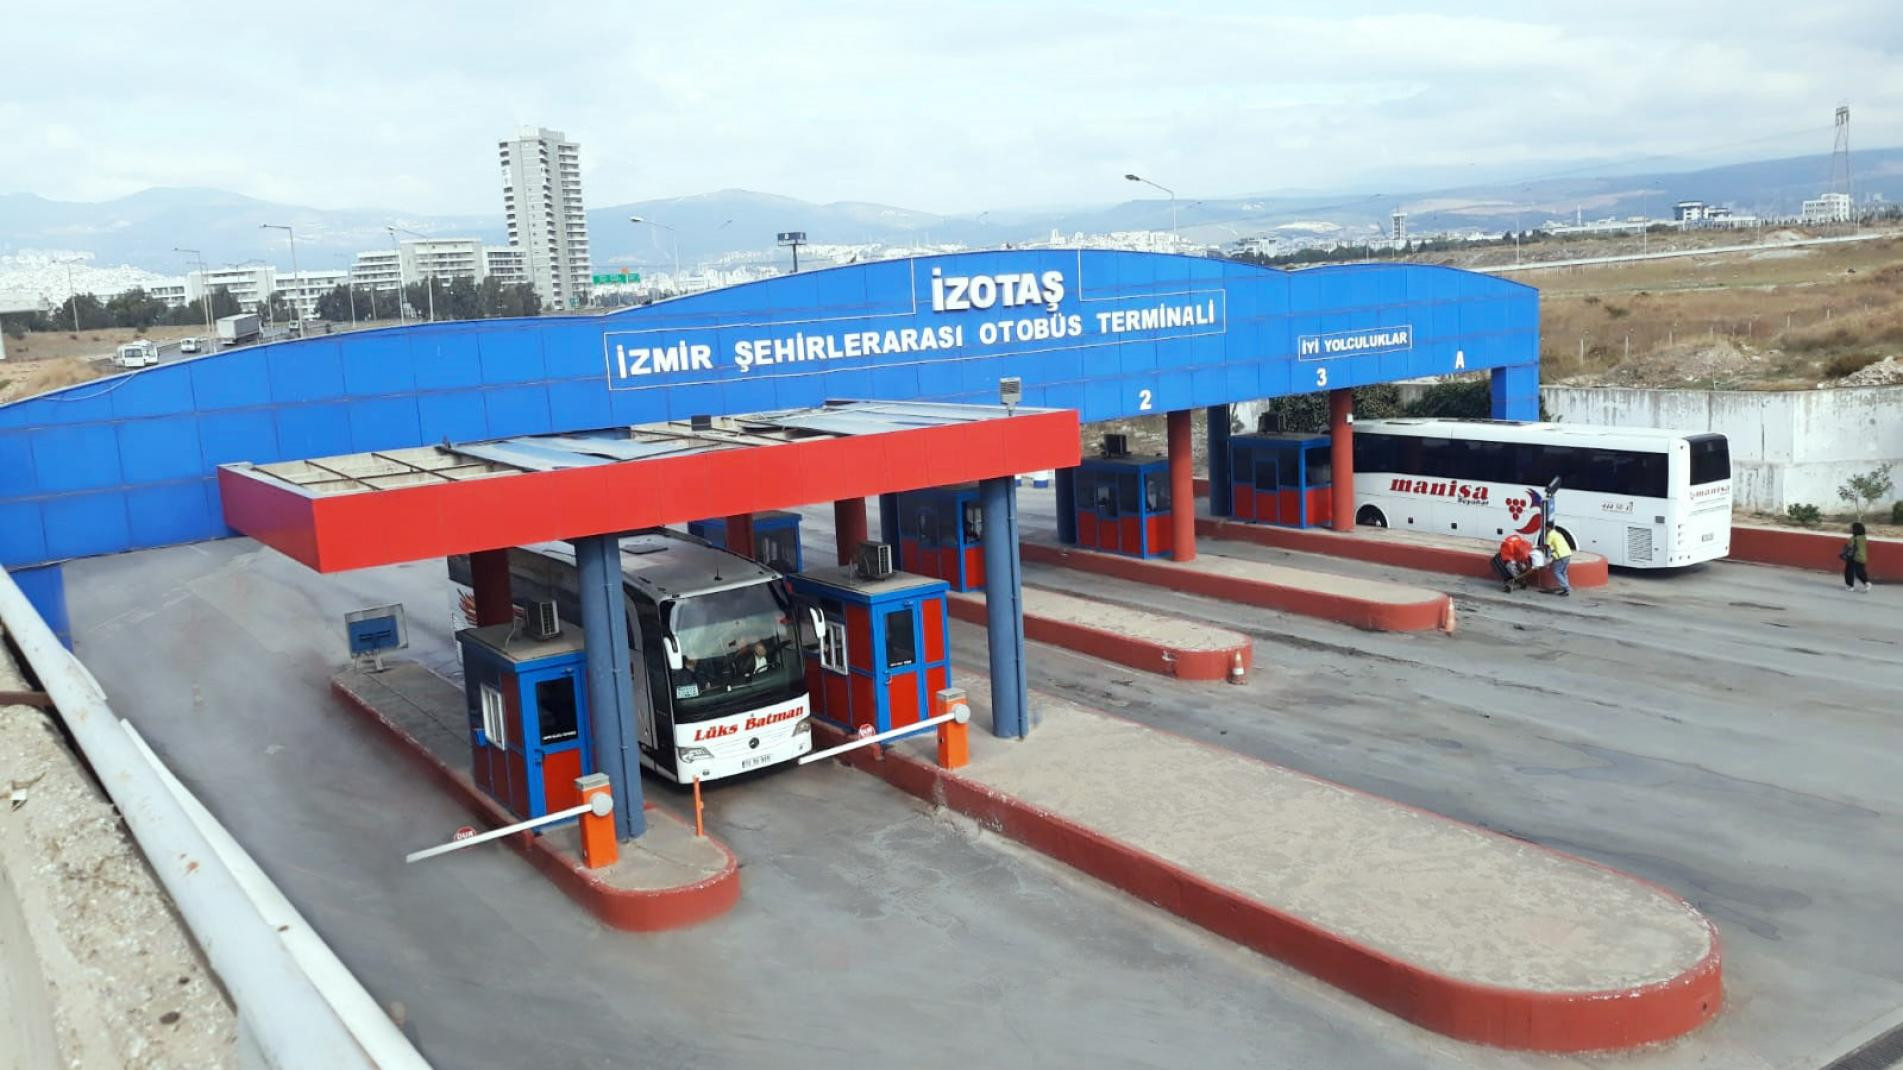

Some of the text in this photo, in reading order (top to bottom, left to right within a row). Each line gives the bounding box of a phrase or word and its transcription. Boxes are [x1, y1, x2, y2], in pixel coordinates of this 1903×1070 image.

[931, 267, 1065, 312] İZOTAŞ
[616, 300, 1215, 378] İZMİR ŞEHİRLERARASI OTOBÜS TERMİNALİ
[1301, 331, 1408, 355] İYİ YOLCULUKLAR
[1455, 350, 1465, 369] A
[1316, 367, 1328, 387] 3
[1138, 389, 1152, 410] 2
[1389, 478, 1489, 501] manisa
[694, 705, 805, 742] Lüks Batman
